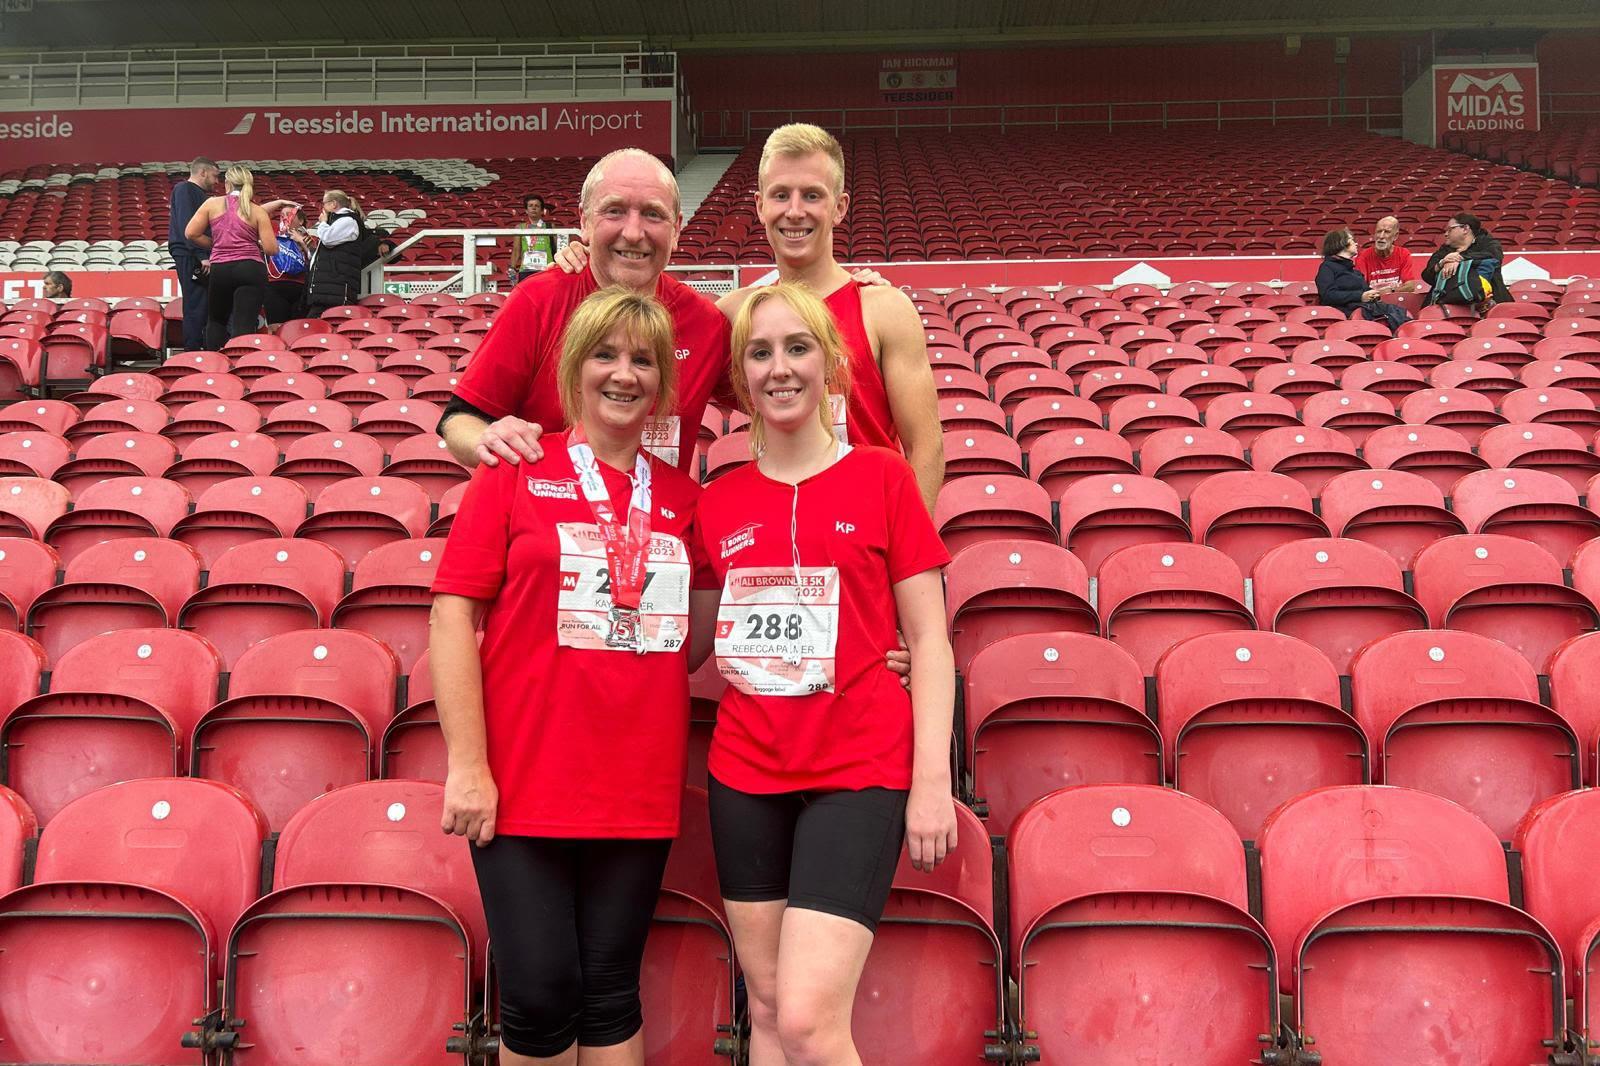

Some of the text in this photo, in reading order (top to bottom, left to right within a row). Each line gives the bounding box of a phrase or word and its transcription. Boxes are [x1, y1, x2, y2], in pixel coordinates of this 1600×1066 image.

[882, 56, 954, 69] IAN HICKMAN
[1447, 95, 1525, 116] MIDAS
[264, 107, 643, 136] Teesside International Airport
[1447, 119, 1525, 131] CLADDING
[674, 349, 691, 360] GP
[645, 431, 669, 440] 2023
[660, 507, 676, 520] KP
[835, 521, 856, 534] KP
[727, 532, 748, 547] BORO
[647, 547, 674, 556] 2023
[720, 537, 755, 559] RUNNERS
[563, 576, 576, 587] M
[741, 576, 755, 587] ALI
[746, 613, 802, 640] 288
[663, 639, 682, 649] 287
[732, 644, 815, 654] REBECCA PAMER
[807, 683, 829, 692] 288
